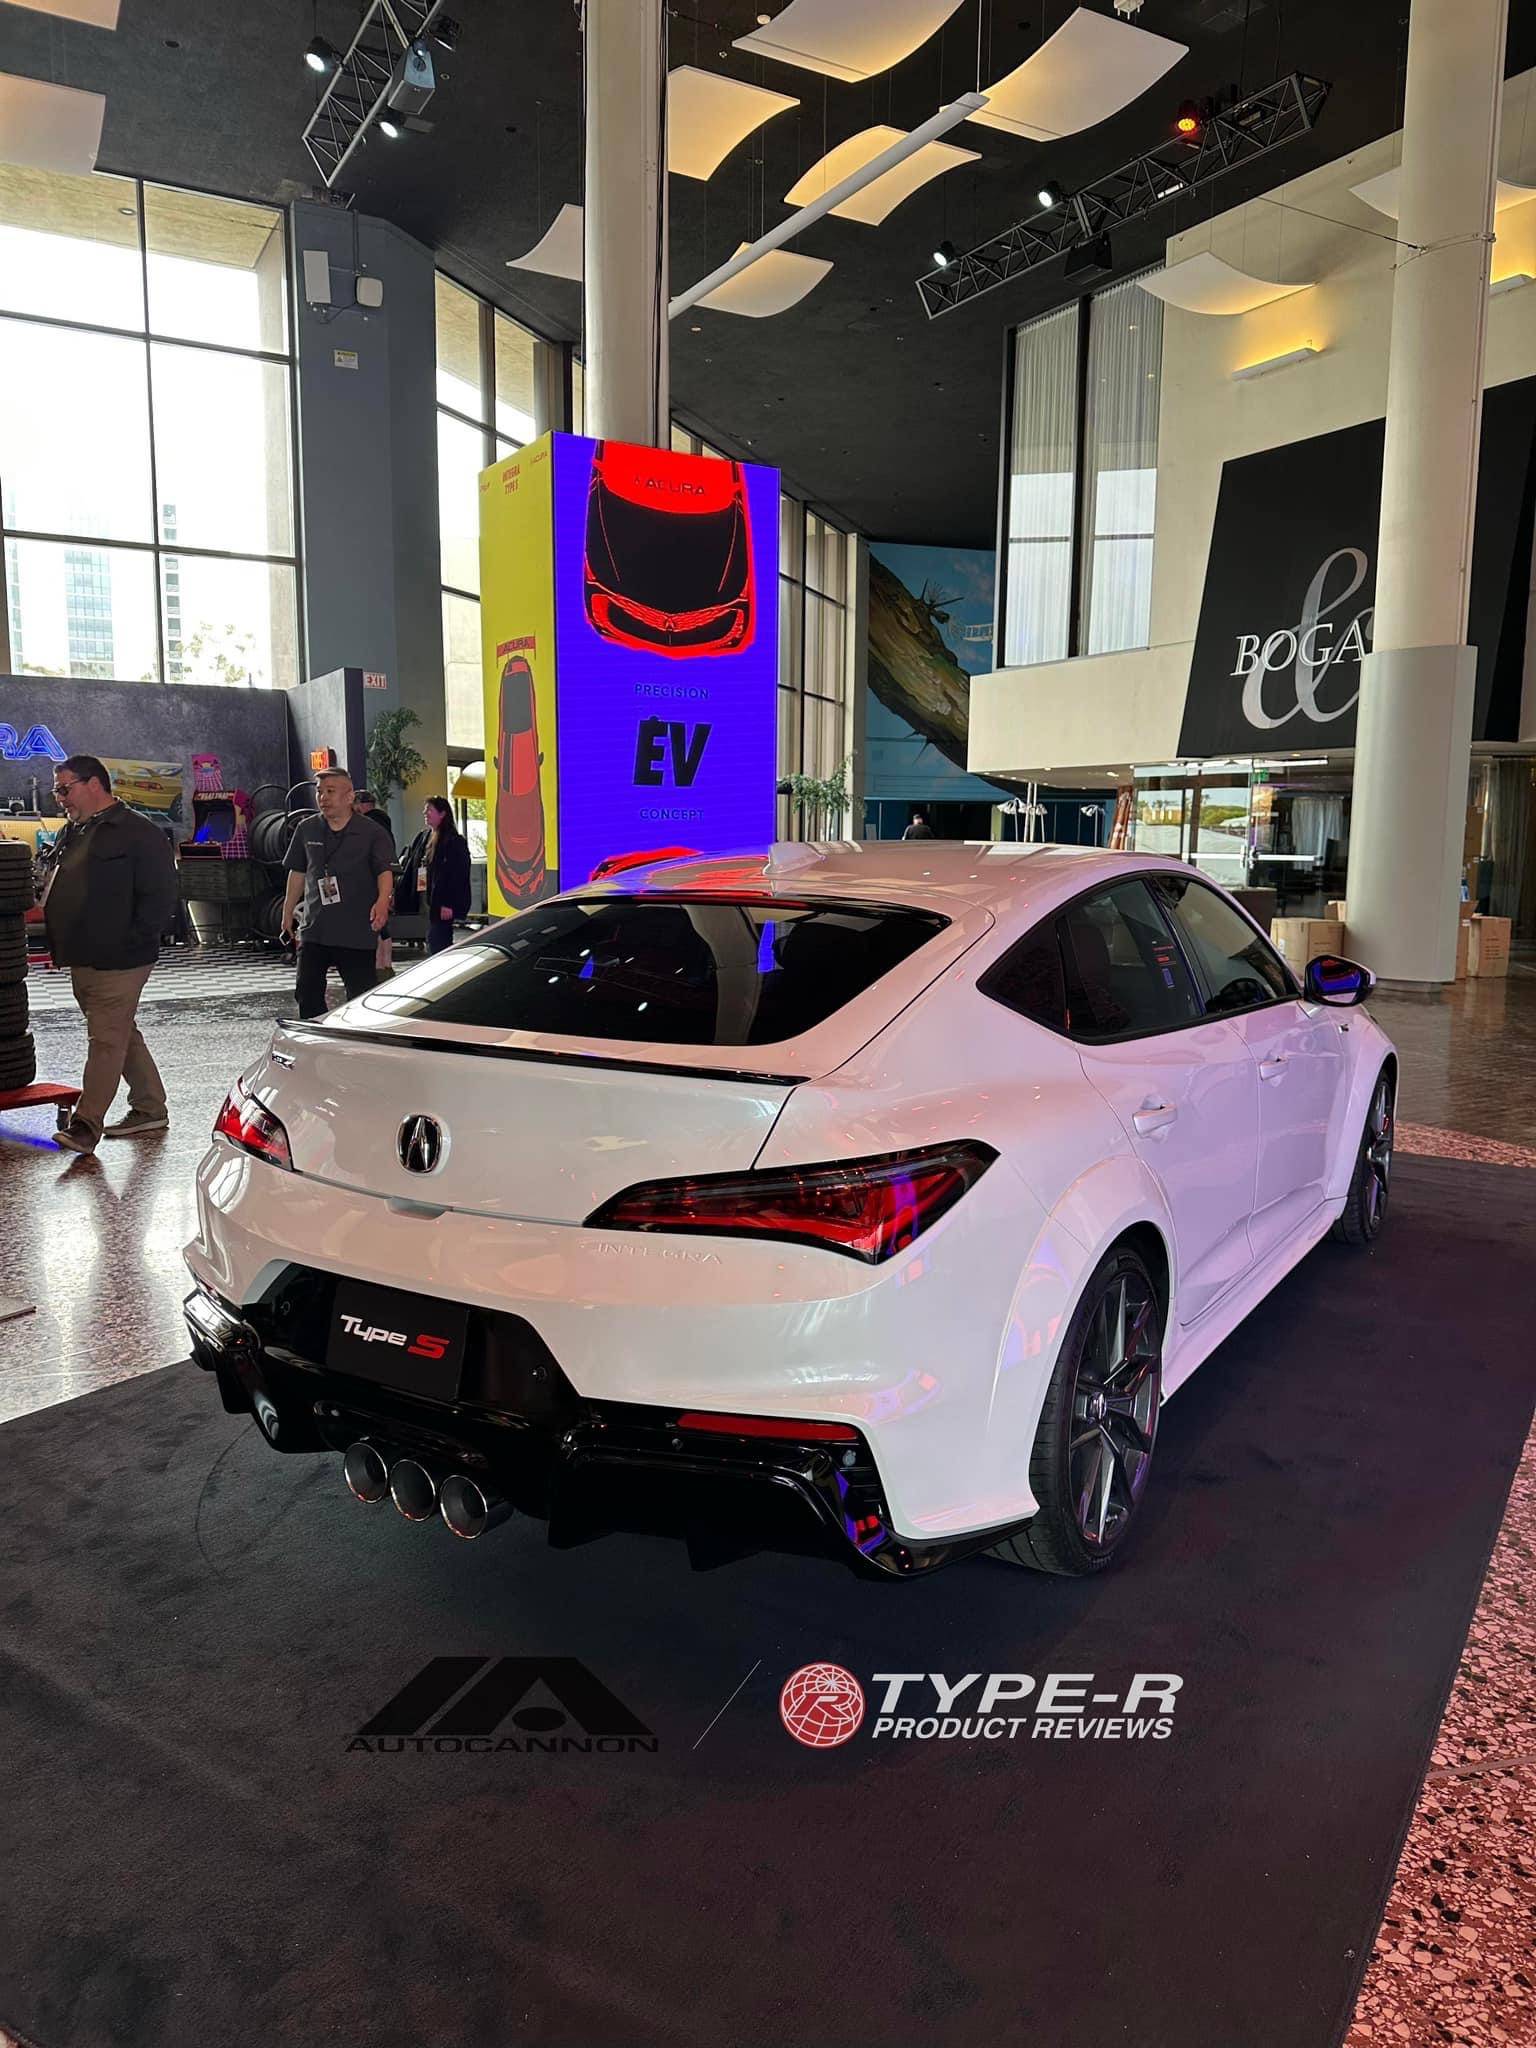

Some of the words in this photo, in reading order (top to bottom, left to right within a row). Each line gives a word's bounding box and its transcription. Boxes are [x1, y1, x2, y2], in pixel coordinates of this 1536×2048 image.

[366, 674, 386, 688] EXIT
[634, 683, 709, 700] PRECISION
[632, 717, 713, 788] EV
[640, 808, 705, 821] CONCEPT
[596, 1241, 723, 1265] INTEGRA
[340, 1314, 407, 1347] Type
[407, 1334, 451, 1359] S
